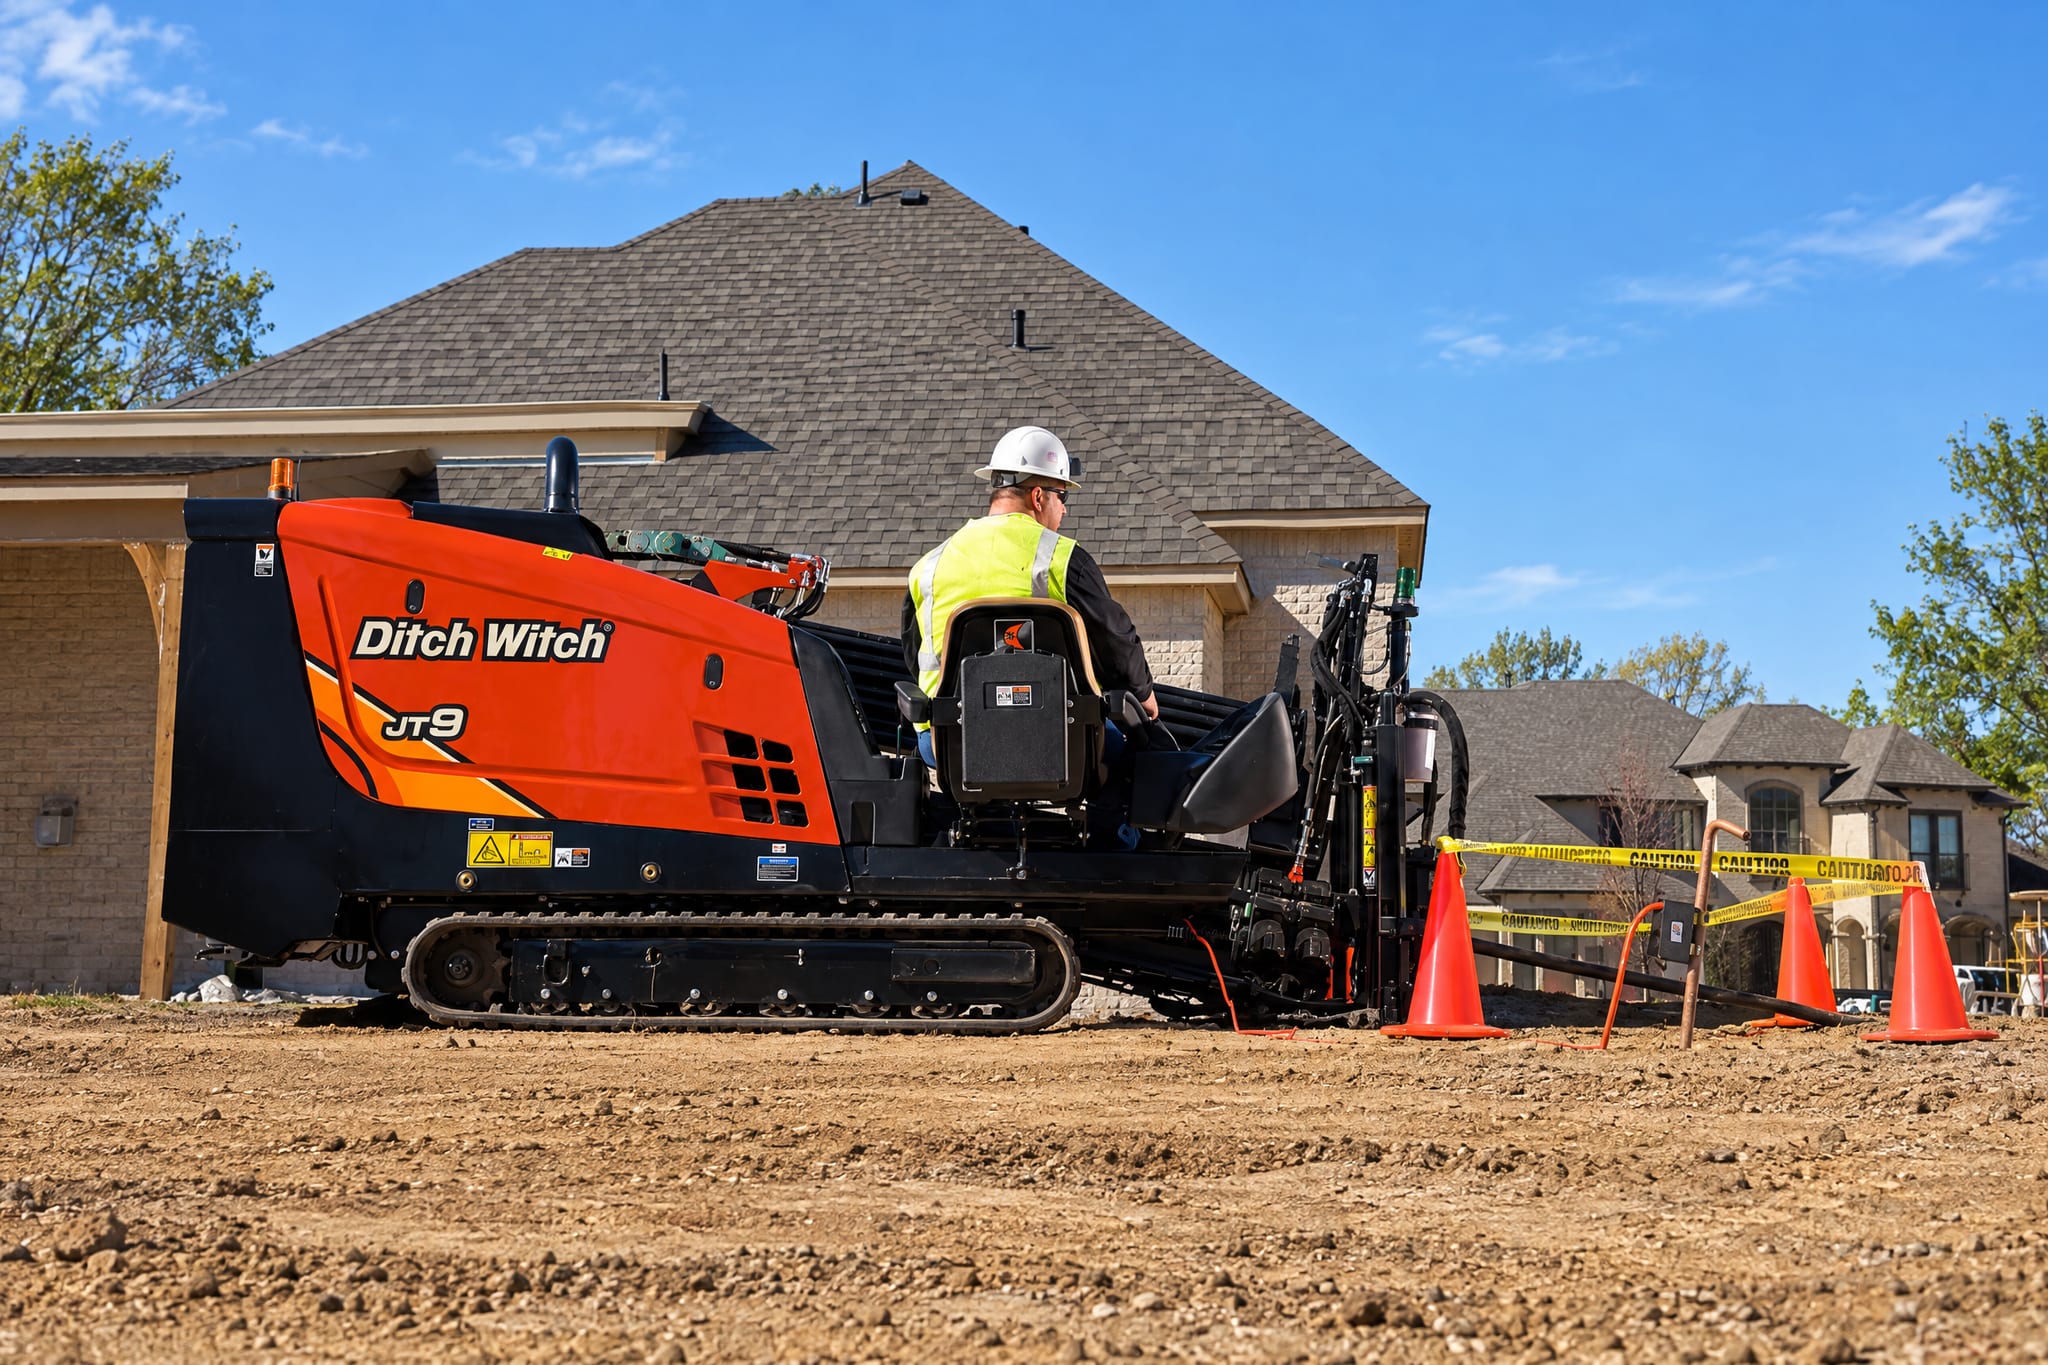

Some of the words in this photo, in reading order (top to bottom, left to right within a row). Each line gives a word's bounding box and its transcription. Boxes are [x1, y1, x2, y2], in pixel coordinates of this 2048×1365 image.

[354, 620, 475, 657] Ditch
[385, 707, 465, 738] JT9
[1629, 851, 1695, 870] CAUTION
